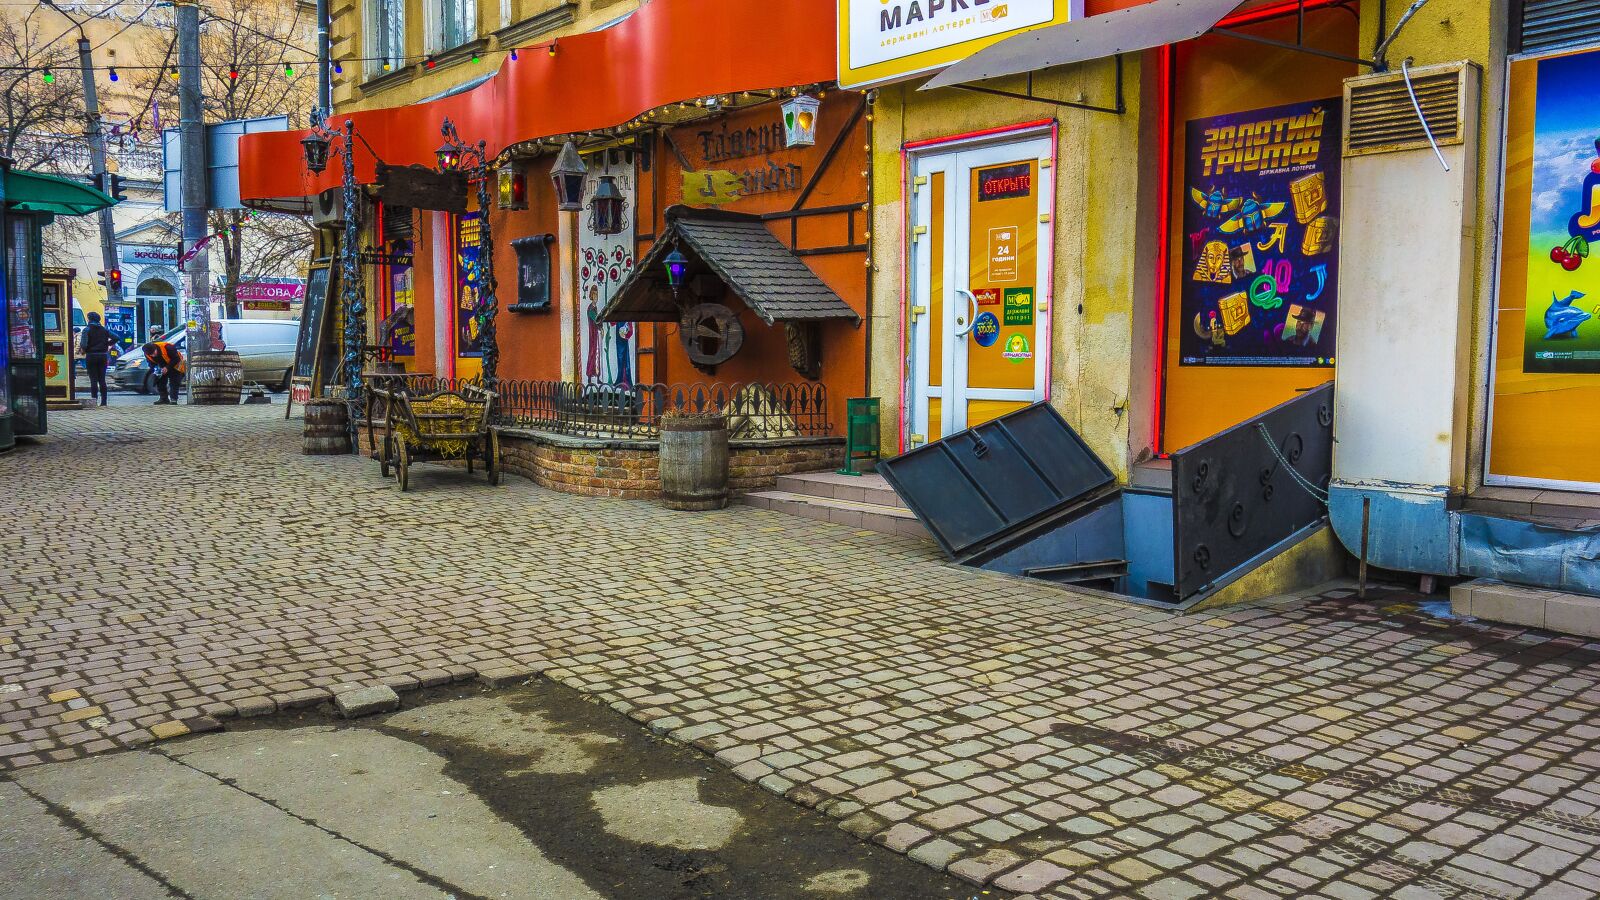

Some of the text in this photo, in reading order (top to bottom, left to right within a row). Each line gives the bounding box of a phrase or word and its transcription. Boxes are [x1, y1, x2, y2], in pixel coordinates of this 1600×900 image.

[880, 0, 990, 32] МАРК
[881, 16, 976, 47] державні лотереї
[697, 120, 787, 161] Таверн
[1202, 106, 1325, 152] ЗОЛОТИЙ
[1201, 140, 1320, 176] ТРІУМФ
[1259, 164, 1316, 176] ДЕРЖАВНА ЛОТЕРЕЯ
[992, 255, 1015, 263] години
[997, 245, 1010, 256] 24
